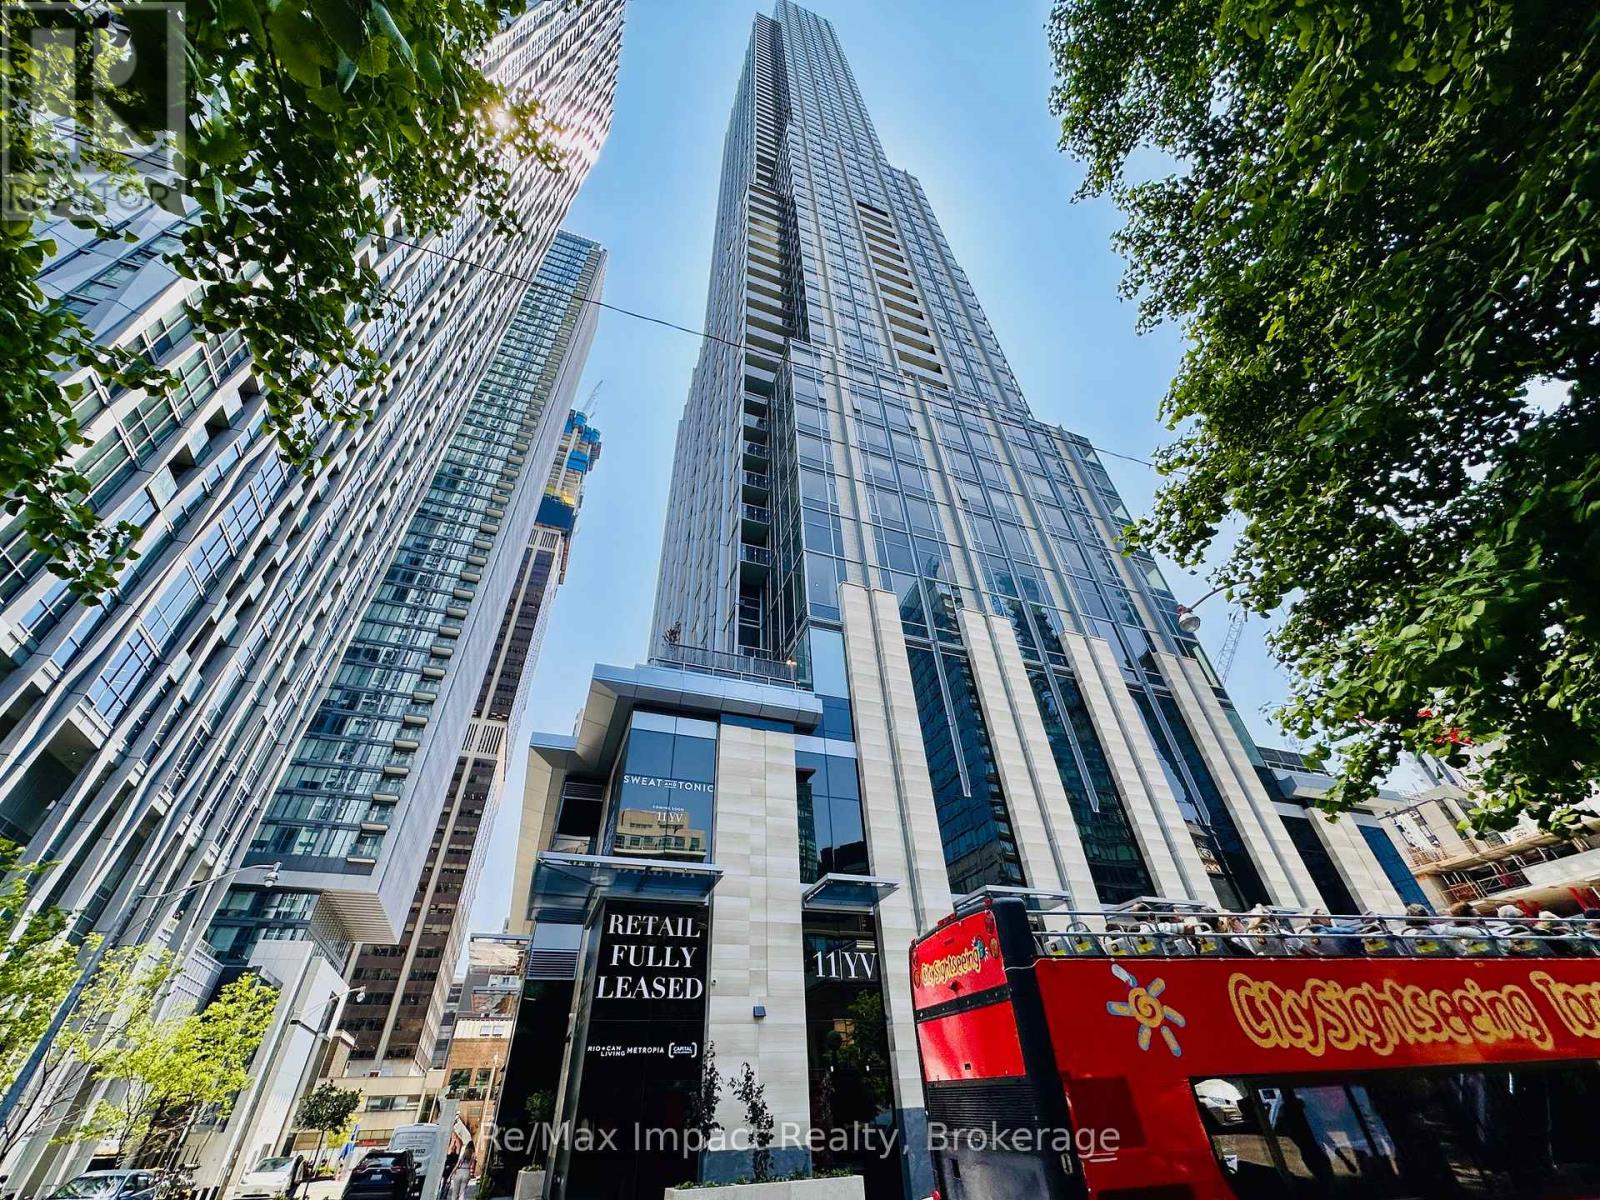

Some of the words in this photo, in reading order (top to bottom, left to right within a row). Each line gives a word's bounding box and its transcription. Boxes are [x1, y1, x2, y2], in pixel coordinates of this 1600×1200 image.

[623, 775, 662, 787] SWEAT
[678, 781, 714, 792] TONIC
[608, 914, 701, 938] RETAIL
[610, 945, 697, 968] FULLY
[596, 976, 703, 1000] LEASED
[626, 1046, 665, 1054] METROPIA
